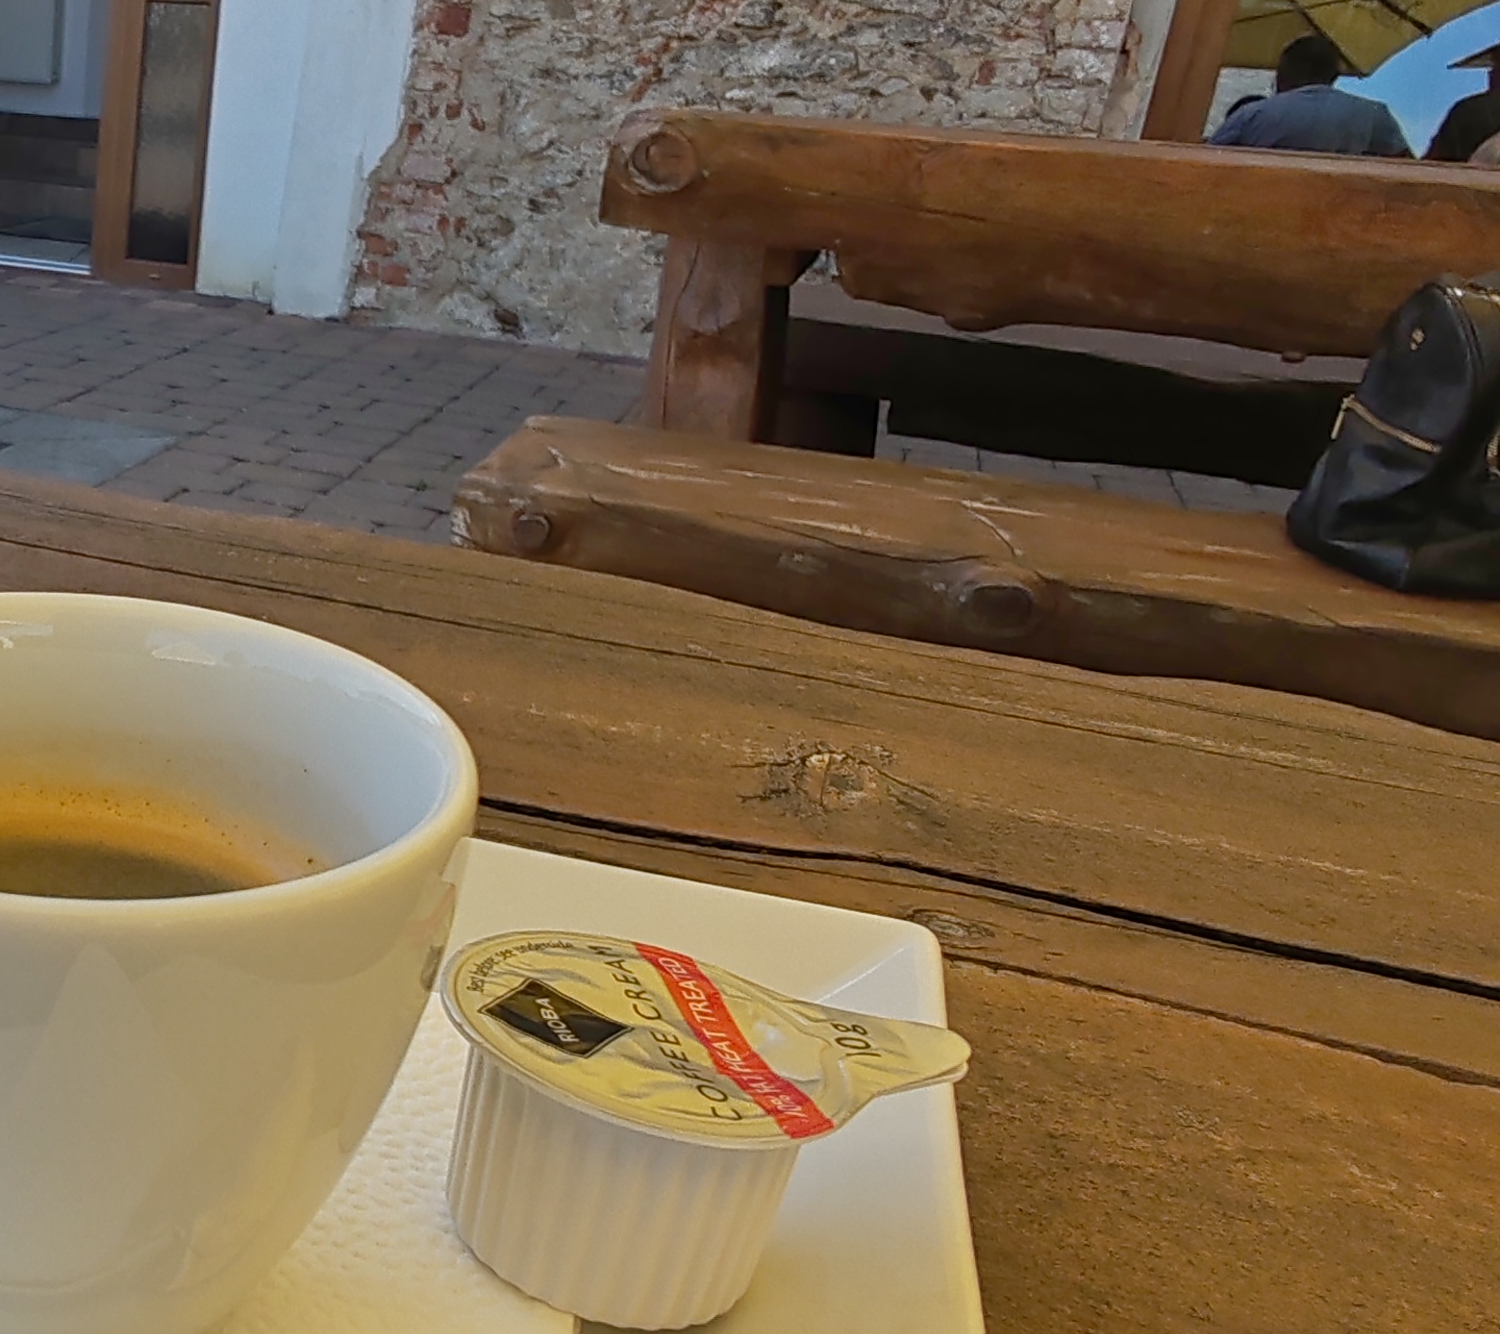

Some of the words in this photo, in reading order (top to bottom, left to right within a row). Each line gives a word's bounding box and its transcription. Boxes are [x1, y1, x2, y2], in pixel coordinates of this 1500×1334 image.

[587, 945, 662, 1021] CREAM
[657, 956, 719, 1023] TREATED
[535, 997, 580, 1043] RIOBA
[701, 1027, 753, 1073] HEAT
[649, 1029, 744, 1122] COFFEE
